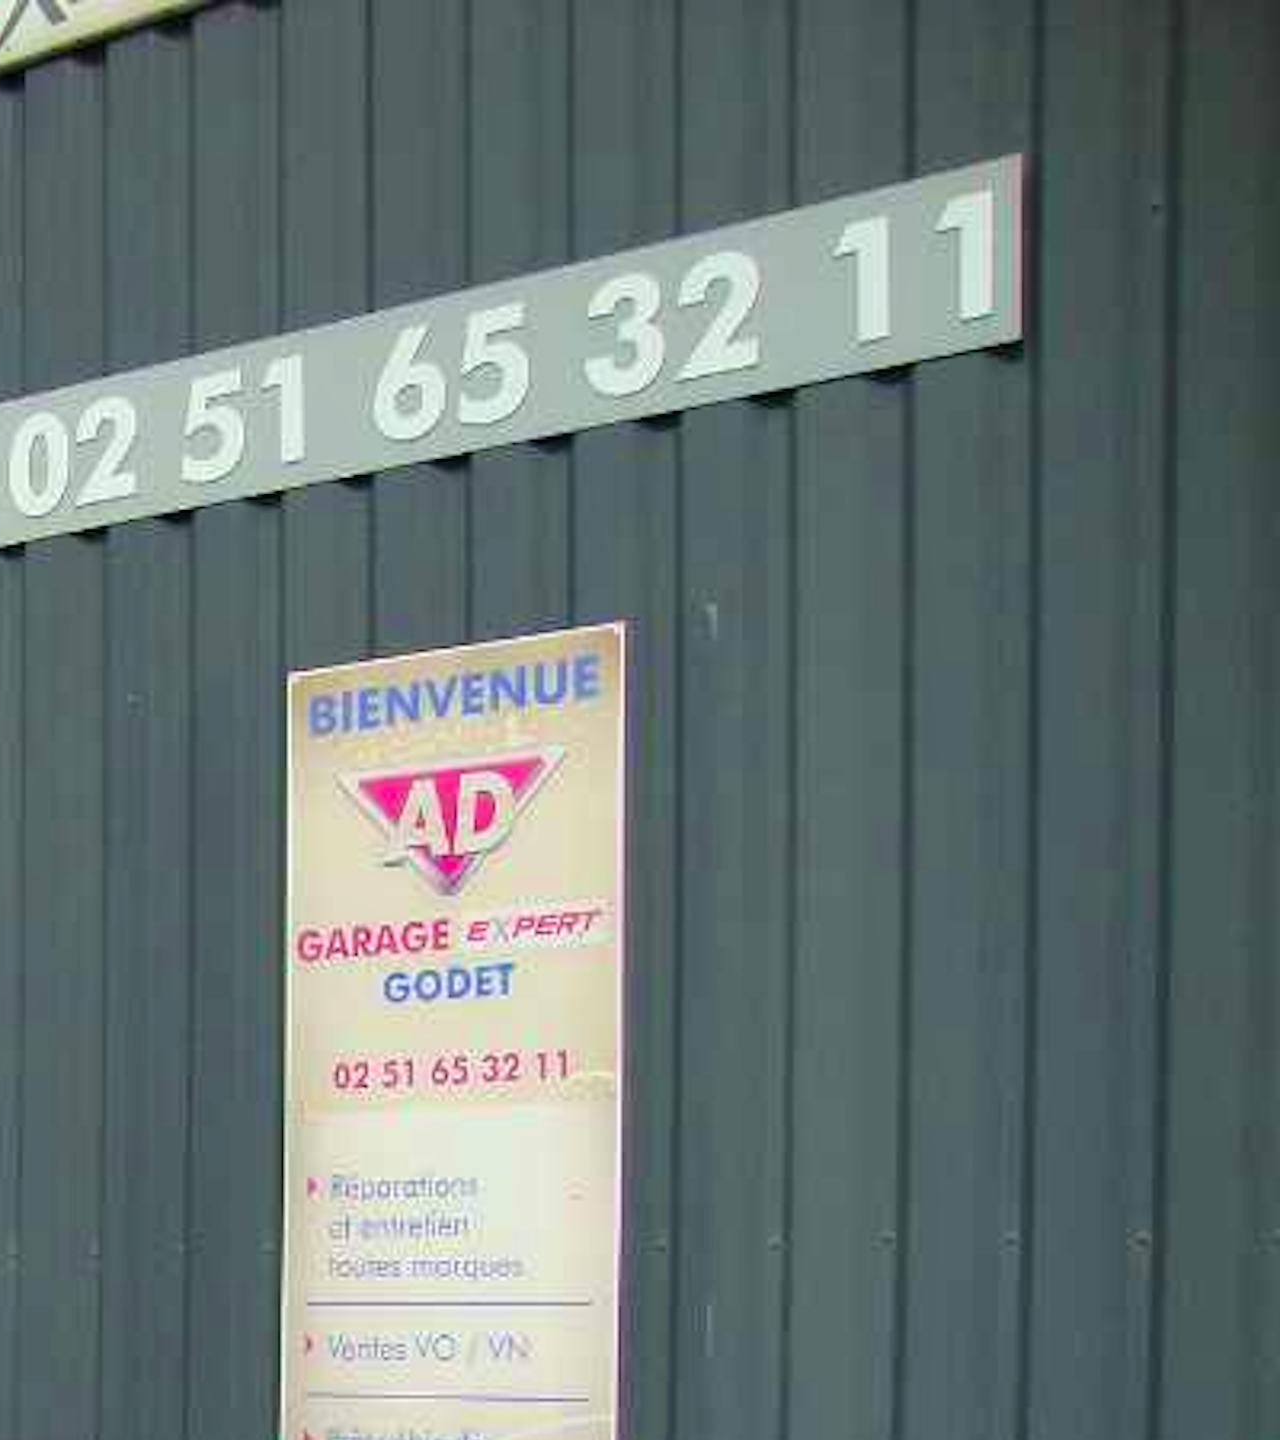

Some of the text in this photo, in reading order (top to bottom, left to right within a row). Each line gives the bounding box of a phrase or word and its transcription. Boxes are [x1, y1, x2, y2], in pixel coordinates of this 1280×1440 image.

[7, 189, 995, 519] 02 51 65 32 11
[307, 654, 601, 736] BIENVENUE
[384, 770, 517, 863] AD
[296, 907, 603, 963] GARAGE EXPERT
[383, 962, 515, 1003] GODET
[333, 1049, 570, 1090] 02 51 65 32 11
